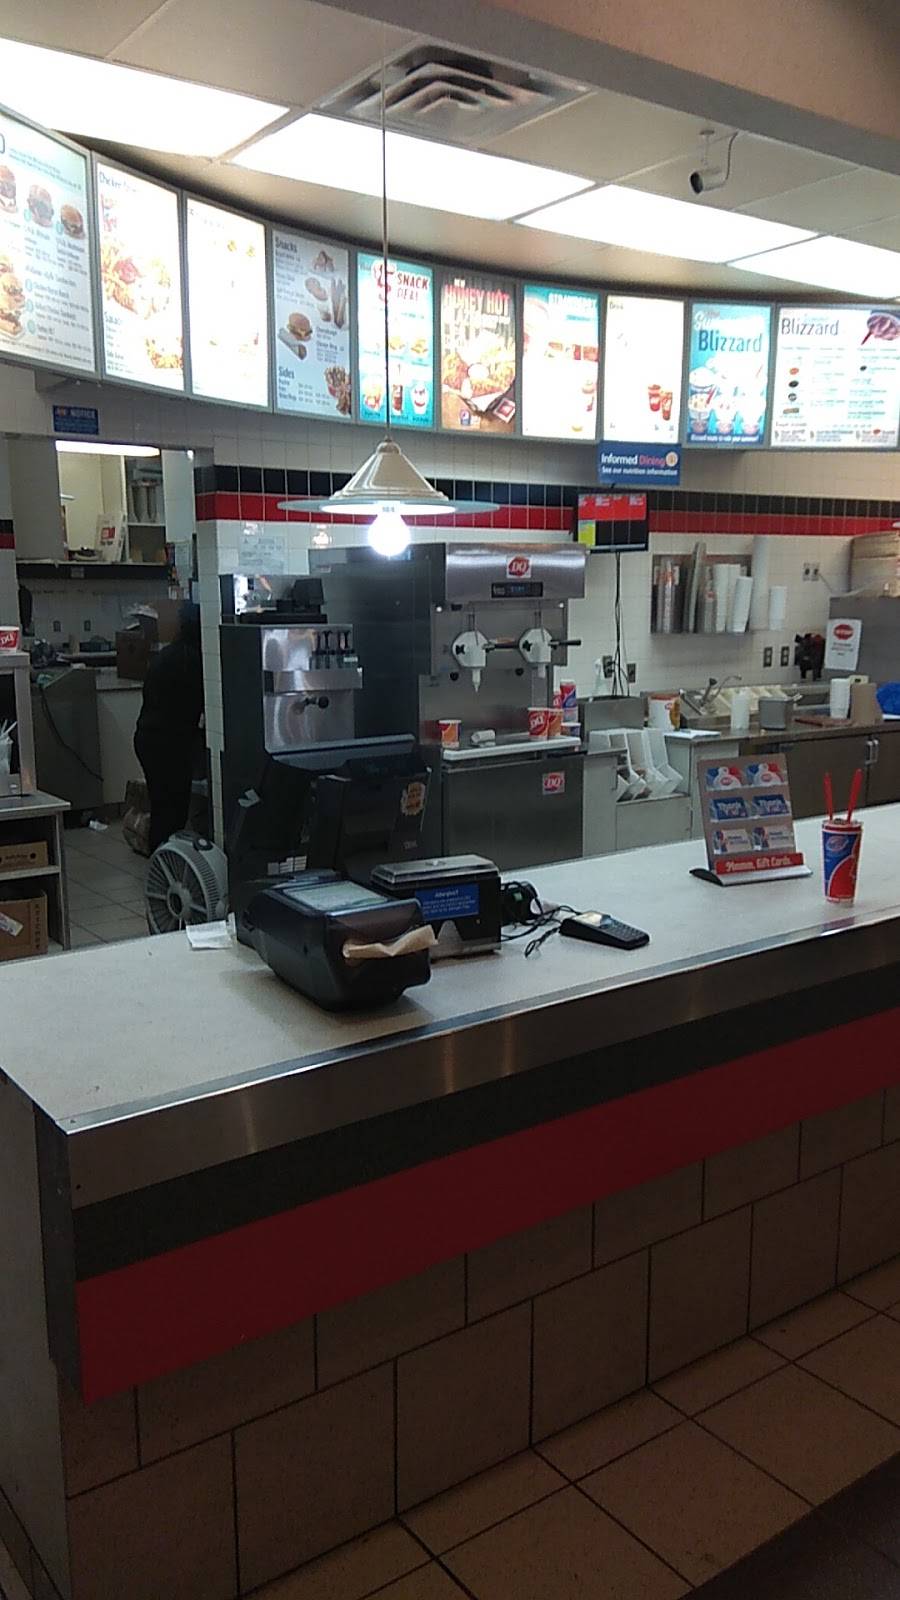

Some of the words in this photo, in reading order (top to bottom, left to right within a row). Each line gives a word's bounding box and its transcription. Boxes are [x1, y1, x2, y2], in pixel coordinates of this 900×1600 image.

[397, 272, 429, 290] SNACK
[780, 318, 840, 337] Blizzard
[698, 329, 763, 353] Blizzard
[601, 452, 639, 466] Informed
[639, 454, 667, 469] Dining
[646, 468, 678, 477] information
[756, 857, 770, 869] Gift
